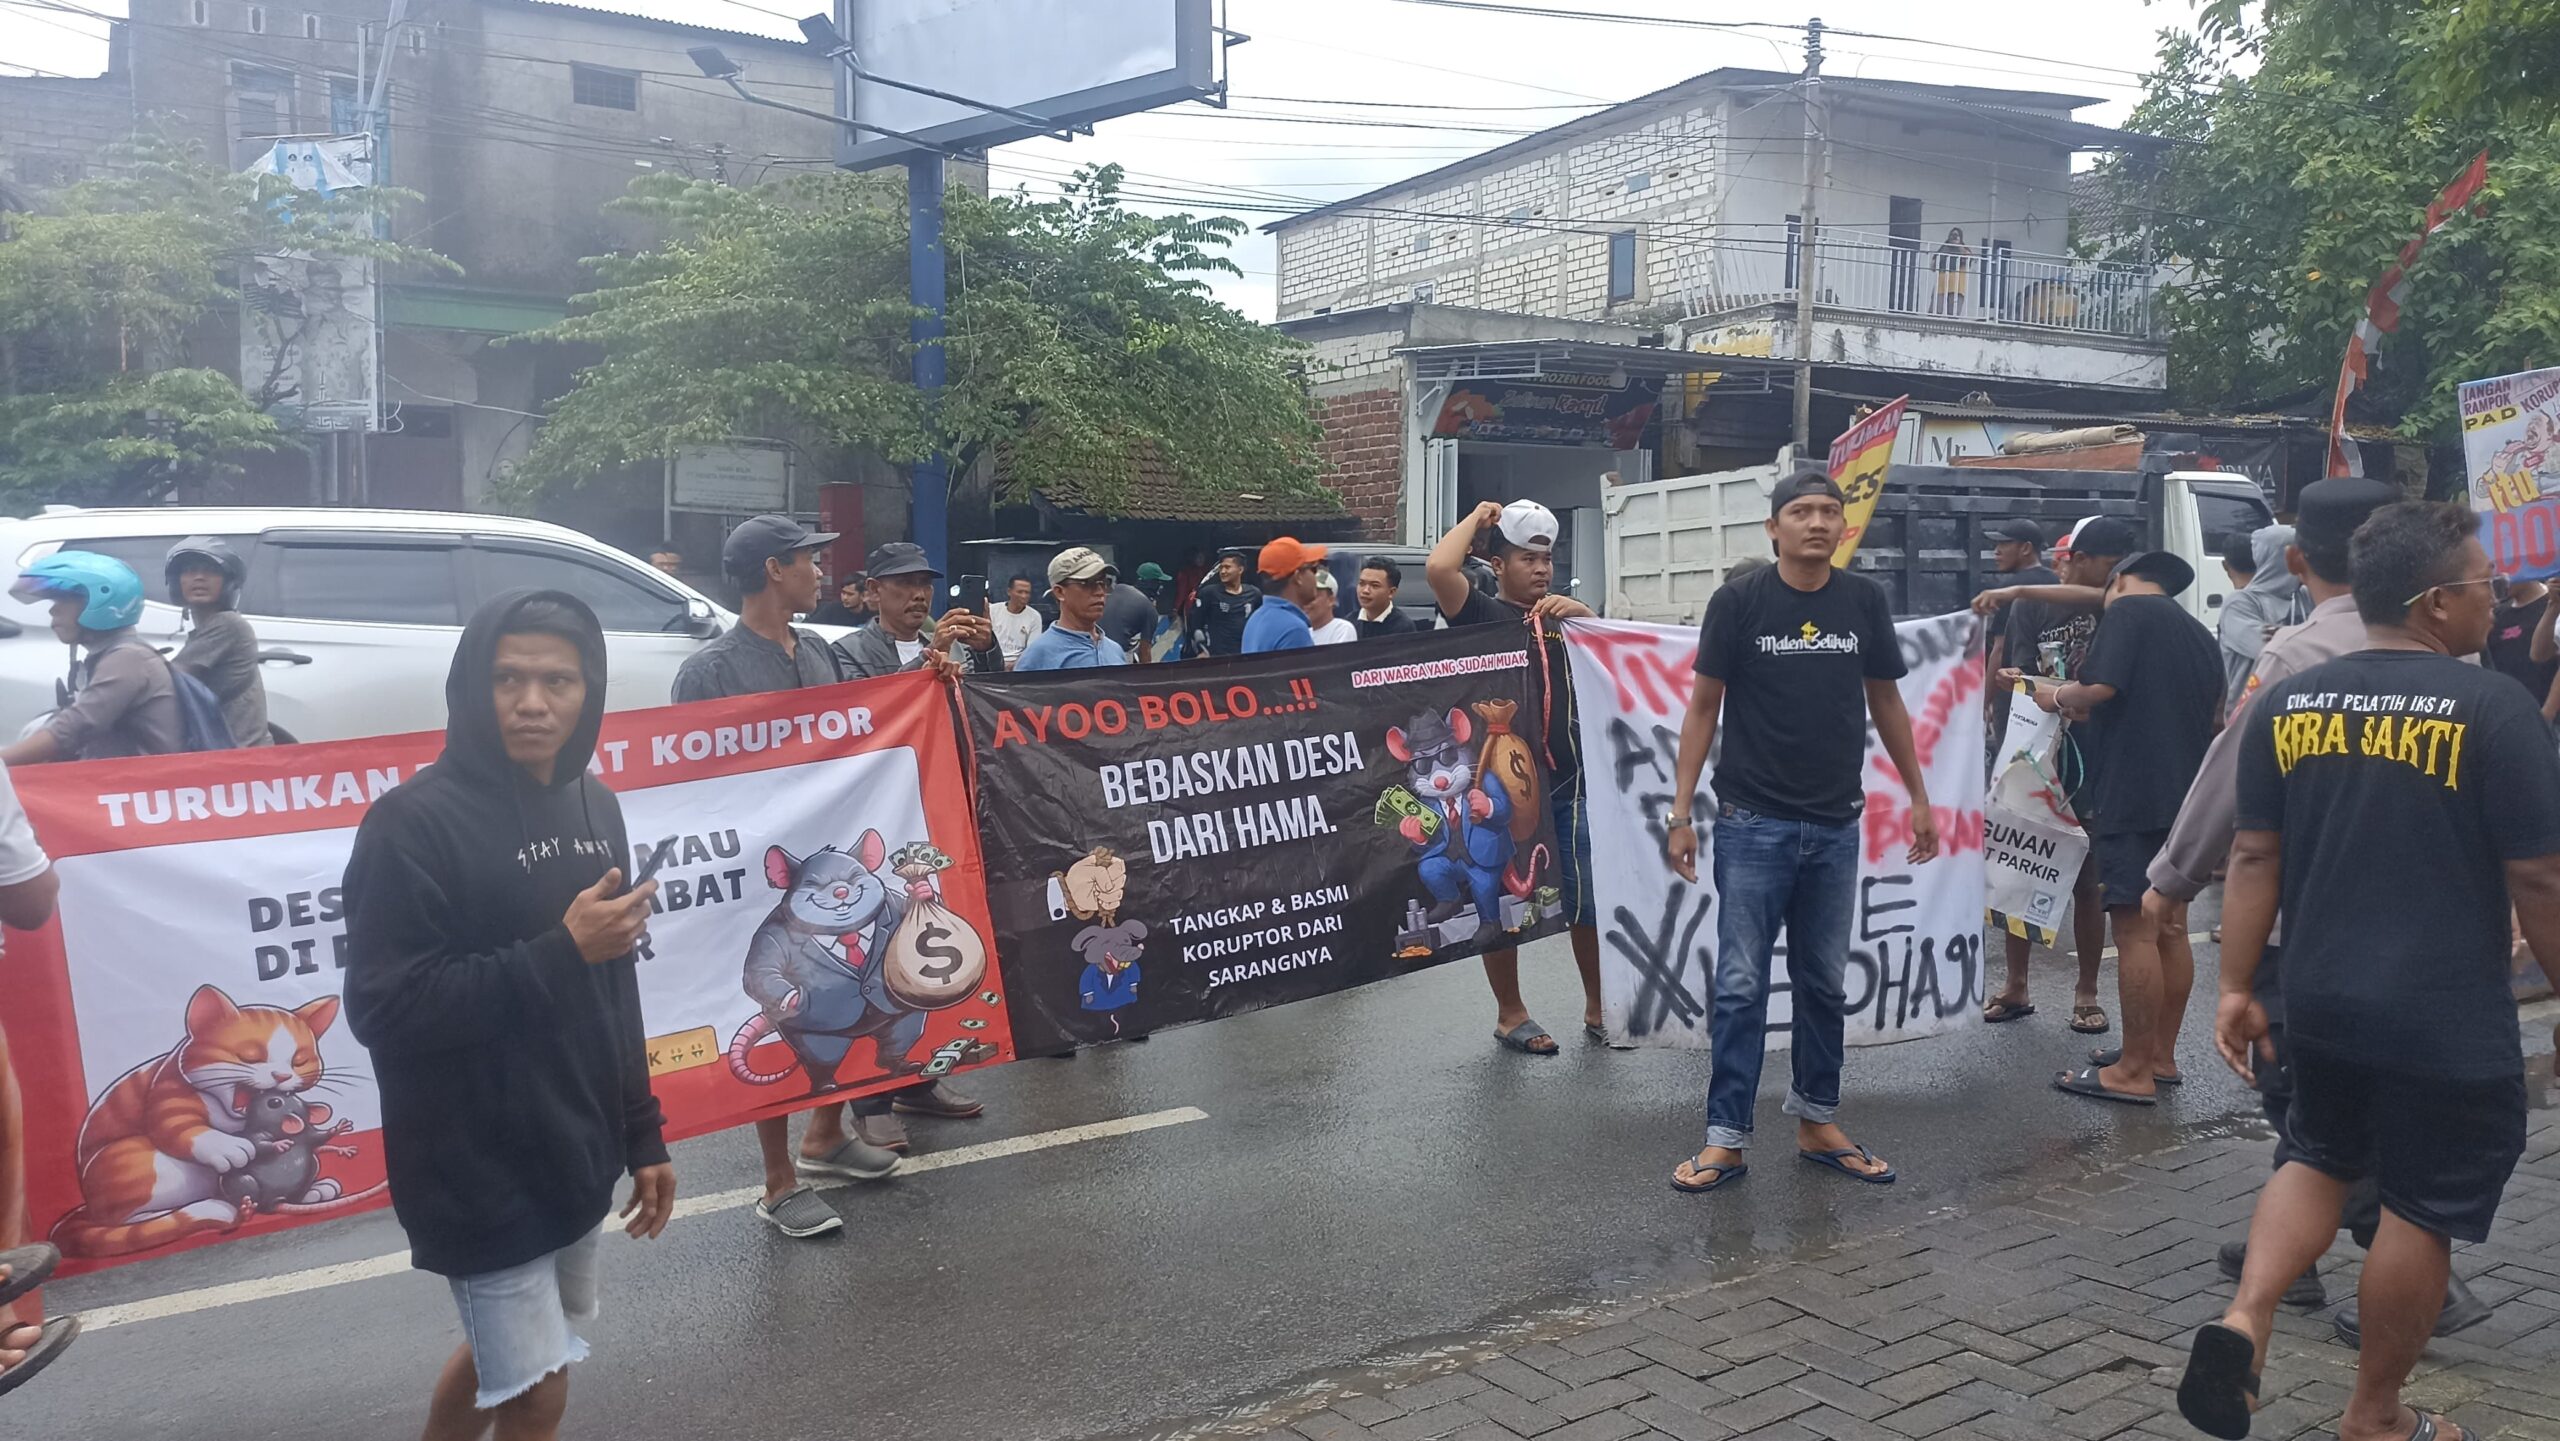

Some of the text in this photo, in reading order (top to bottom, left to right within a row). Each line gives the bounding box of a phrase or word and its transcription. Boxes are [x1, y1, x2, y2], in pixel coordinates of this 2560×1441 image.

[2464, 392, 2512, 416] RAMPOK
[2520, 377, 2560, 413] KORUP
[2465, 407, 2517, 431] PAD
[1352, 671, 1383, 687] DARI
[1384, 663, 1427, 683] WARGA
[1426, 660, 1456, 677] YANG
[1457, 654, 1494, 672] SUDAH
[993, 698, 1128, 749] AYOO
[2342, 694, 2406, 712] PELATIH
[98, 766, 401, 827] TURUNKAN
[652, 706, 874, 766] KORUPTOR
[1100, 731, 1365, 808] BEBASKAN DESA
[2360, 715, 2466, 791] SAKTI
[1147, 795, 1338, 864] DARI HAMA.
[1997, 850, 2060, 883] PARKIR
[247, 886, 346, 933] DES
[1170, 884, 1350, 936] TANGKAP & BASMI
[255, 938, 319, 981] DI
[1183, 914, 1343, 963] KORUPTOR DARI
[1208, 946, 1333, 989] SARANGNYA
